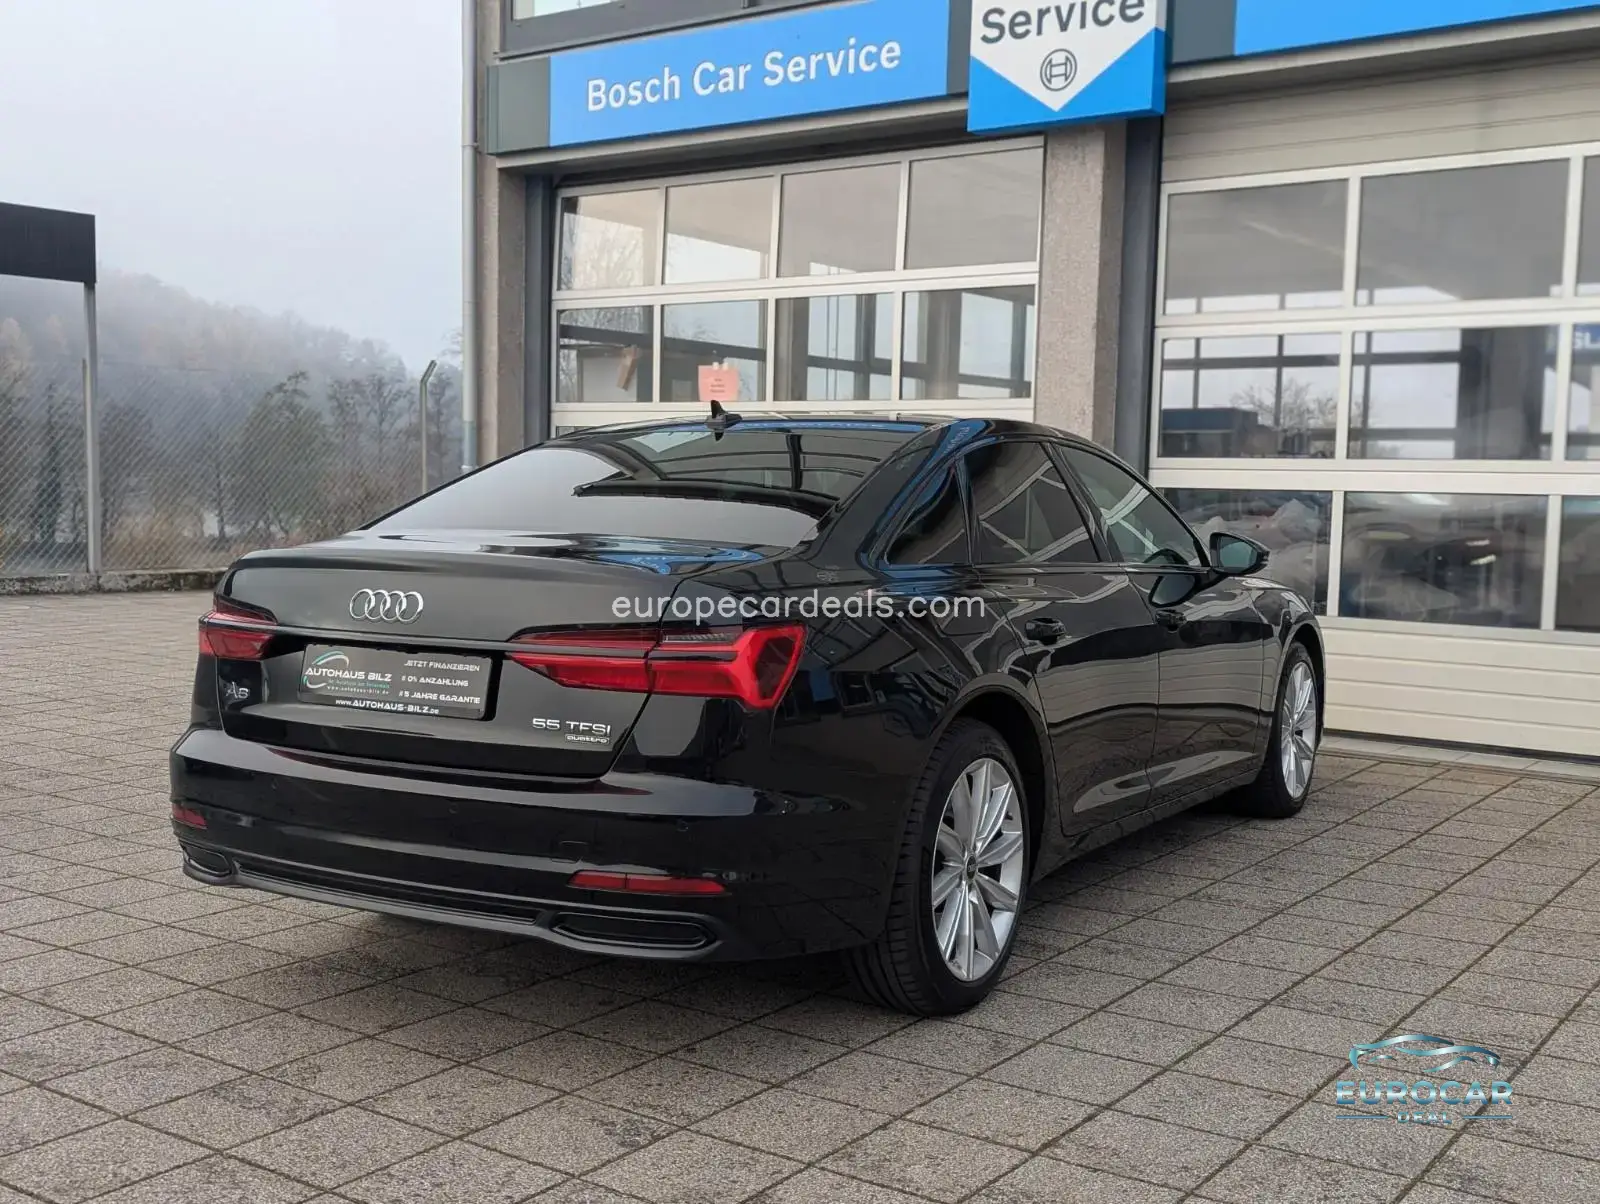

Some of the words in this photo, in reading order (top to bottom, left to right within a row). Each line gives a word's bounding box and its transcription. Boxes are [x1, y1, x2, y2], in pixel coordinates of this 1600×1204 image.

[980, 0, 1145, 44] Service
[587, 65, 681, 112] Bosch
[692, 61, 752, 96] Car
[763, 37, 901, 86] Service
[404, 660, 428, 668] JETZT
[428, 661, 480, 672] FINANZIEREN
[305, 667, 366, 679] AUTOHAUS
[367, 672, 393, 682] BILZ
[419, 677, 469, 687] ANZAHLUNG
[225, 681, 249, 699] A6
[411, 691, 438, 700] JAHRE
[438, 694, 481, 704] GARANTIE
[532, 717, 560, 730] 55
[565, 720, 611, 736] TFSI
[566, 734, 609, 744] quattro
